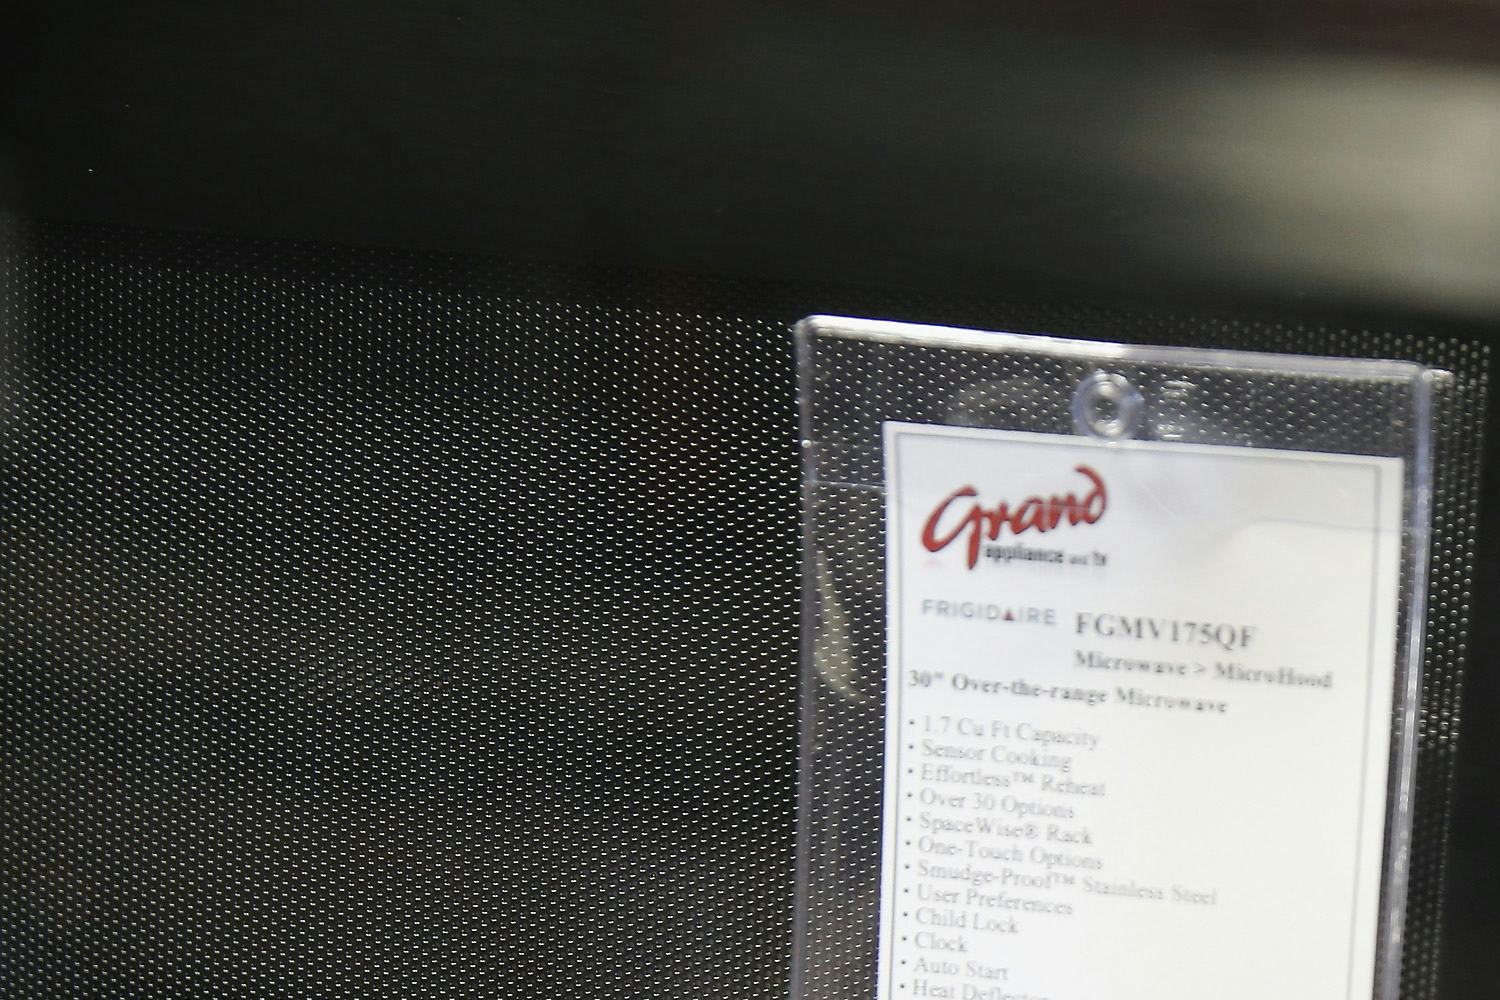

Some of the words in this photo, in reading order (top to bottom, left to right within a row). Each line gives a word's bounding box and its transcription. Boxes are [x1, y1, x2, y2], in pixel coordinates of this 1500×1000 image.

[921, 464, 1109, 570] Grand
[921, 597, 1058, 626] FRIGIDAIRE
[1074, 611, 1258, 651] FGMV175QF
[1073, 648, 1187, 677] Microwave
[1212, 661, 1333, 690] MicroHood
[951, 673, 1109, 706] Over-the-range
[1114, 685, 1229, 714] Microwave
[1016, 722, 1098, 751] Capacity
[922, 739, 986, 761] Sensor
[990, 745, 1073, 773] Cooking
[1041, 774, 1106, 797] Reheat
[919, 787, 967, 809] Over
[1001, 795, 1076, 820] Options
[1046, 823, 1094, 845] Rack
[918, 835, 1025, 863] One-Touch
[1029, 846, 1103, 871] Options
[917, 883, 961, 905] User
[966, 888, 1075, 916] Preferences
[1081, 873, 1165, 900] Stainless
[1171, 884, 1219, 906] Steel
[915, 906, 968, 929] Child
[972, 911, 1020, 935] Lock
[914, 930, 969, 953] Clock
[913, 956, 960, 977] Auto
[965, 958, 1009, 982] Start
[913, 978, 956, 999] Heat
